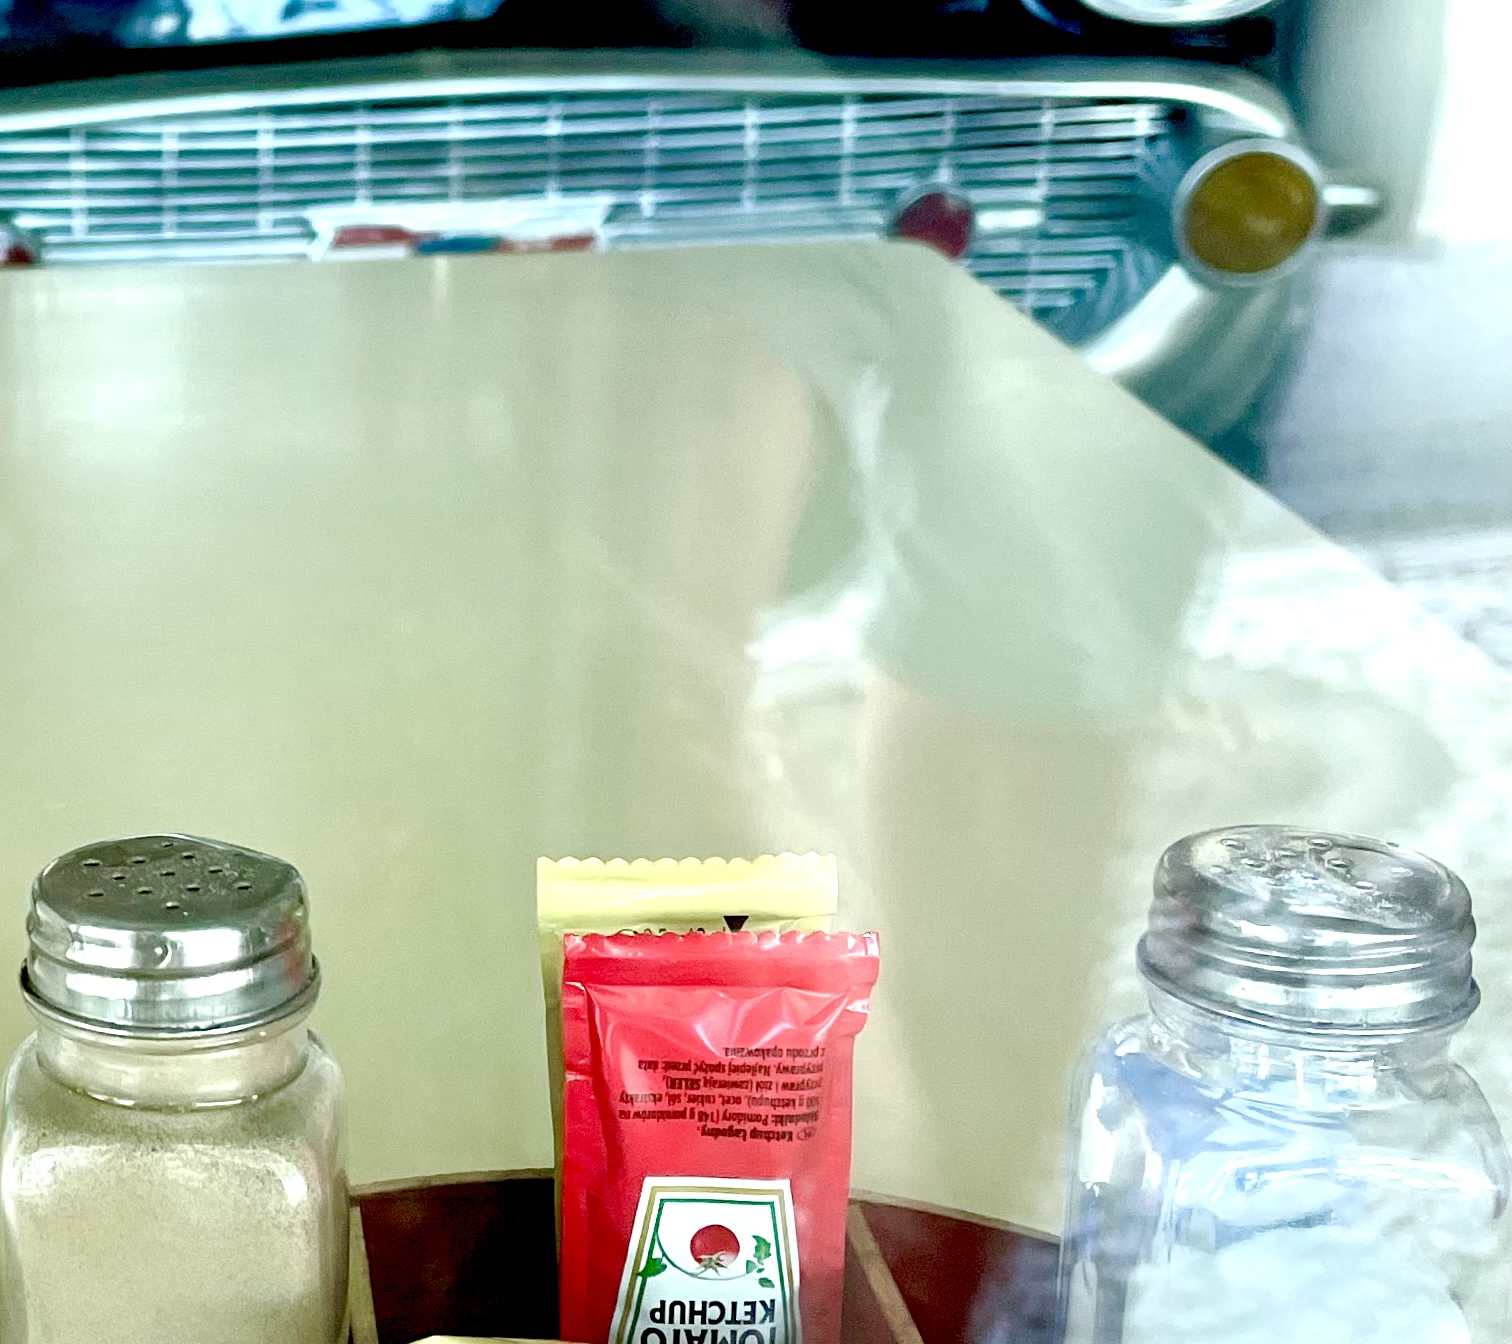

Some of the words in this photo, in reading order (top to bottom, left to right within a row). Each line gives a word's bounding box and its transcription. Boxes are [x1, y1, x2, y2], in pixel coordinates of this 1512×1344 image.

[722, 1109, 768, 1124] Pomidory
[750, 1127, 793, 1142] Ketchup
[650, 1299, 776, 1325] KETCHUP
